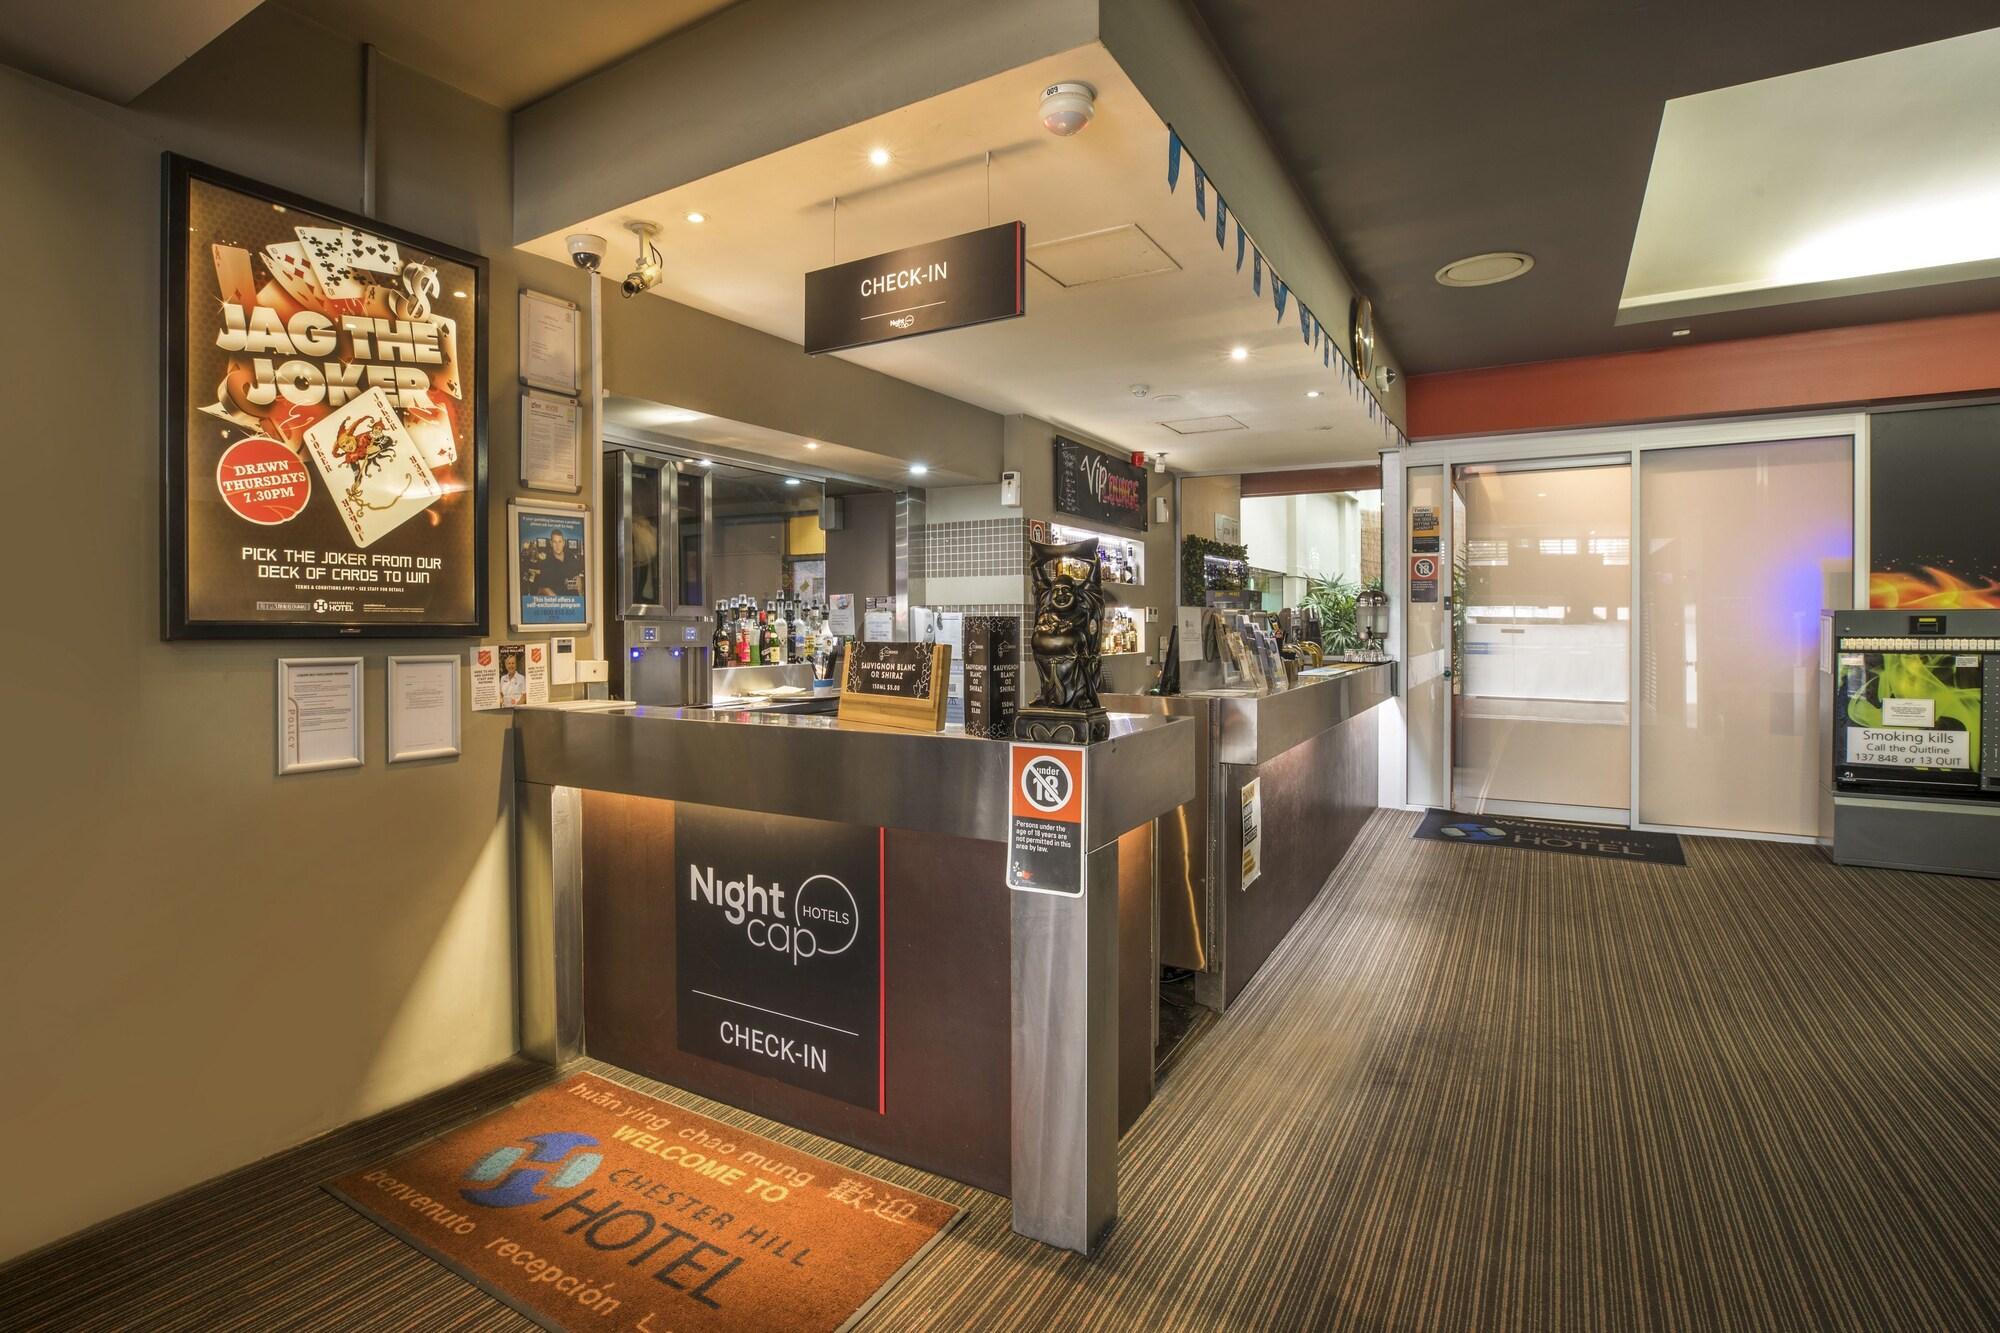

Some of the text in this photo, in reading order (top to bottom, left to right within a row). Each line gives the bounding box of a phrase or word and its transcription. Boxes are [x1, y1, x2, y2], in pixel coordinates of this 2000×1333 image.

[860, 262, 948, 296] CHECK-IN
[215, 303, 442, 364] JAG THE
[246, 358, 436, 408] JOKER
[233, 460, 289, 477] DRAWN
[222, 472, 306, 492] THURSDAYS
[244, 486, 295, 504] 7.30PM
[242, 547, 442, 570] PICK THE JOKER FROM OUR
[258, 564, 430, 584] DECK OF CARDS TO WIN
[861, 662, 916, 672] SAUVIGNON BLANC
[870, 670, 903, 680] OR SHIRAZ
[966, 664, 987, 672] SAUVIGNON
[288, 708, 296, 750] POLICY
[1863, 730, 1954, 744] Smoking kills
[1866, 743, 1950, 755] Call the Quitline
[1856, 753, 1875, 762] 137
[1878, 754, 1898, 763] 848
[1920, 756, 1932, 764] 13
[1936, 757, 1962, 766] QUIT
[1036, 766, 1060, 776] under
[1032, 776, 1059, 802] 18
[1016, 820, 1066, 832] Persons under the
[1028, 828, 1034, 836] of
[1040, 831, 1057, 840] years
[1494, 819, 1600, 834] Welcome
[1026, 837, 1054, 847] permitted
[1060, 840, 1072, 848] this
[1030, 844, 1036, 852] by
[1037, 844, 1048, 852] law.
[1514, 834, 1645, 856] HOTEL
[690, 864, 786, 925] Night
[802, 905, 850, 925] HOTELS
[748, 918, 817, 966] cap
[720, 1021, 827, 1073] CHECK-IN
[611, 1125, 790, 1202] WELCOME TO
[678, 1128, 736, 1155] chao
[737, 1150, 816, 1188] mung
[608, 1168, 812, 1268] CHESTER HILL
[363, 1169, 622, 1316] benvenuto recepción
[538, 1188, 745, 1310] HOTEL
